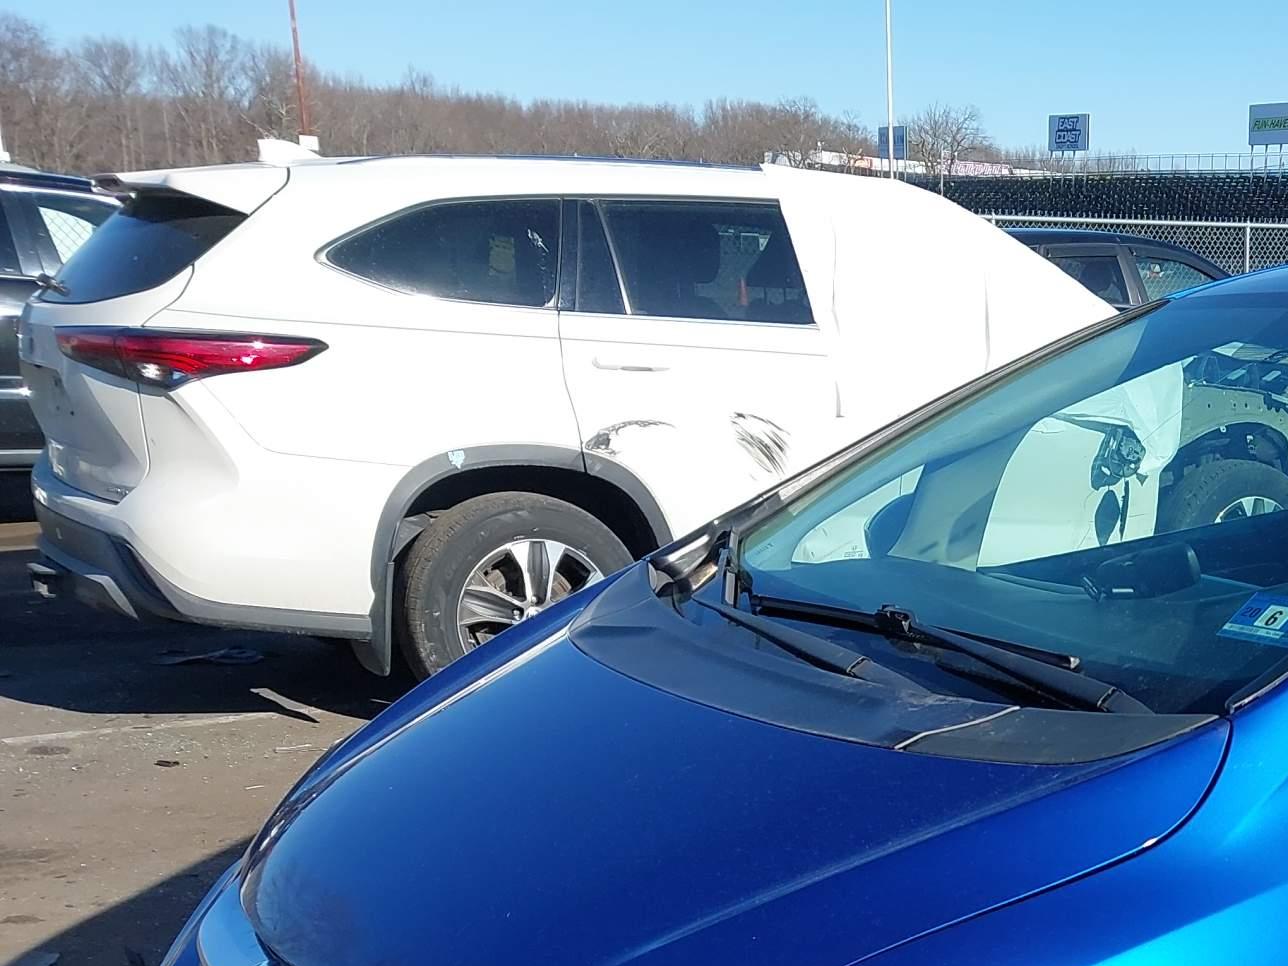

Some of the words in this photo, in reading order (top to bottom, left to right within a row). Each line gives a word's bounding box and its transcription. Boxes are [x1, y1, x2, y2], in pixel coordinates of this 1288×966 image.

[1058, 117, 1079, 130] EAST
[1055, 130, 1081, 144] COAST
[1263, 610, 1283, 627] 6
